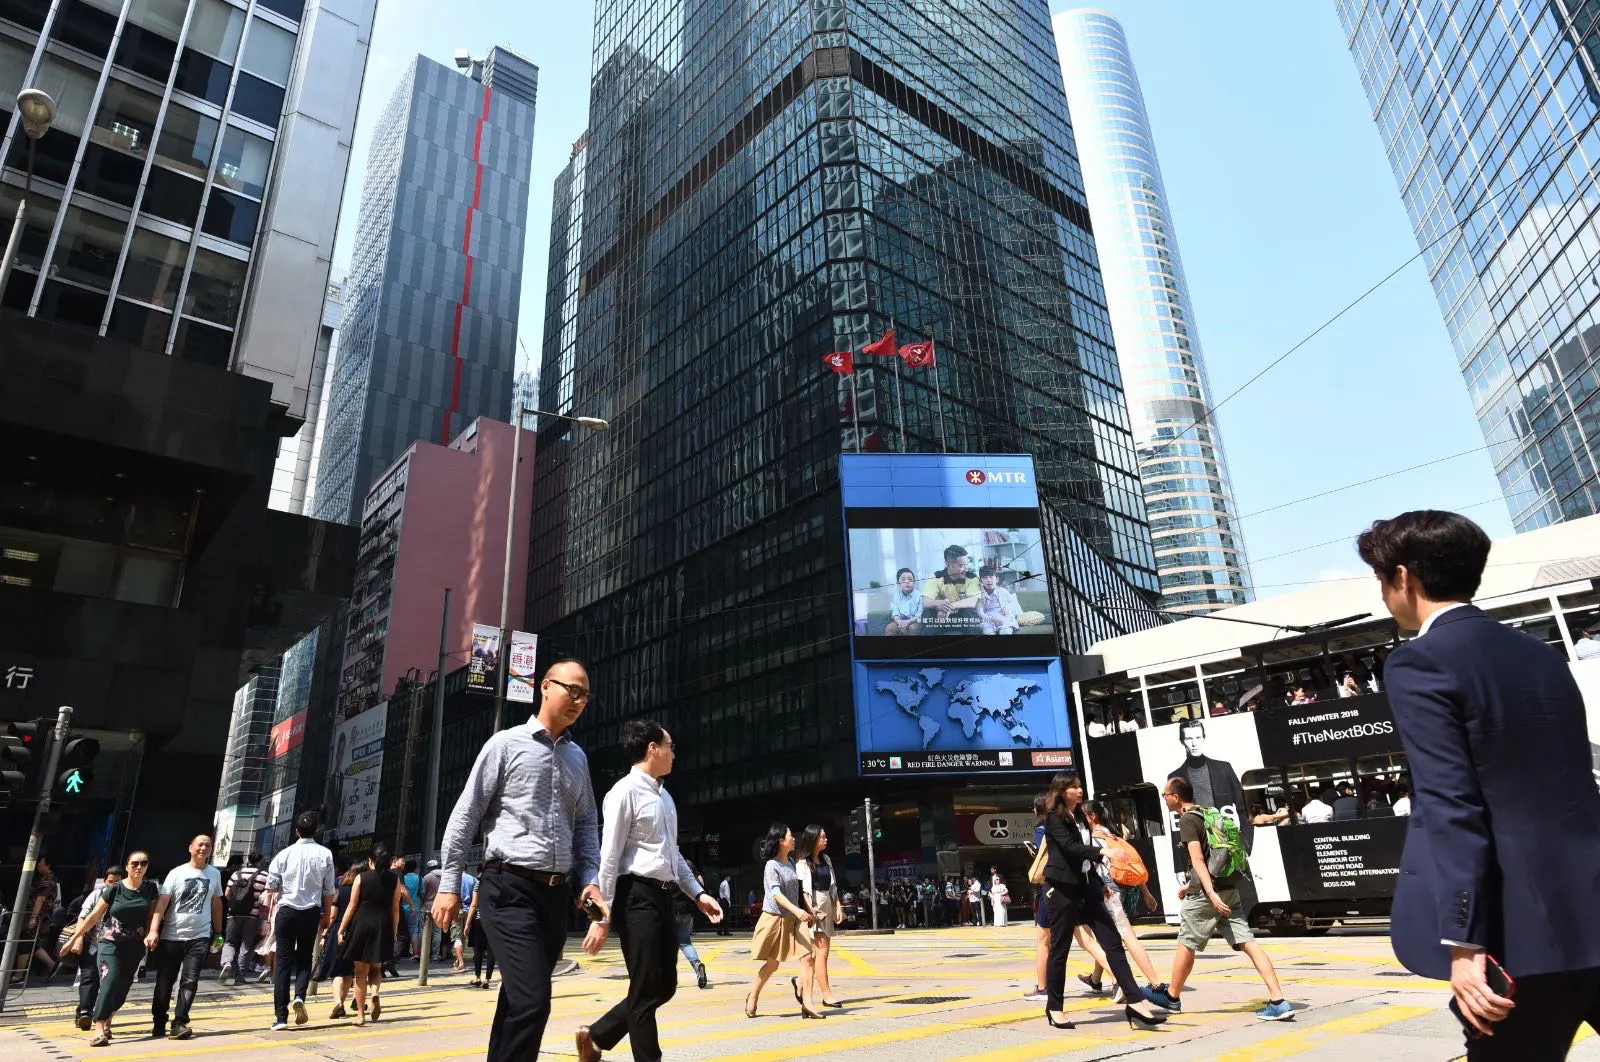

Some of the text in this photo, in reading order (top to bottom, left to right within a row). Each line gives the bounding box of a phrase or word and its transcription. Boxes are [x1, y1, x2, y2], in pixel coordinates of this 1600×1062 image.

[988, 471, 1026, 484] MTR
[512, 653, 534, 667] 香港
[5, 665, 34, 689] 行
[1288, 709, 1360, 726] FALL/WINTER 2018
[1292, 721, 1394, 746] #TheNextBOSS
[1313, 833, 1371, 844] CENTRAL BUILDING
[1316, 849, 1348, 857] ELEMENTS
[1319, 863, 1345, 871] CANTON
[1323, 880, 1356, 888] BOSS.COM
